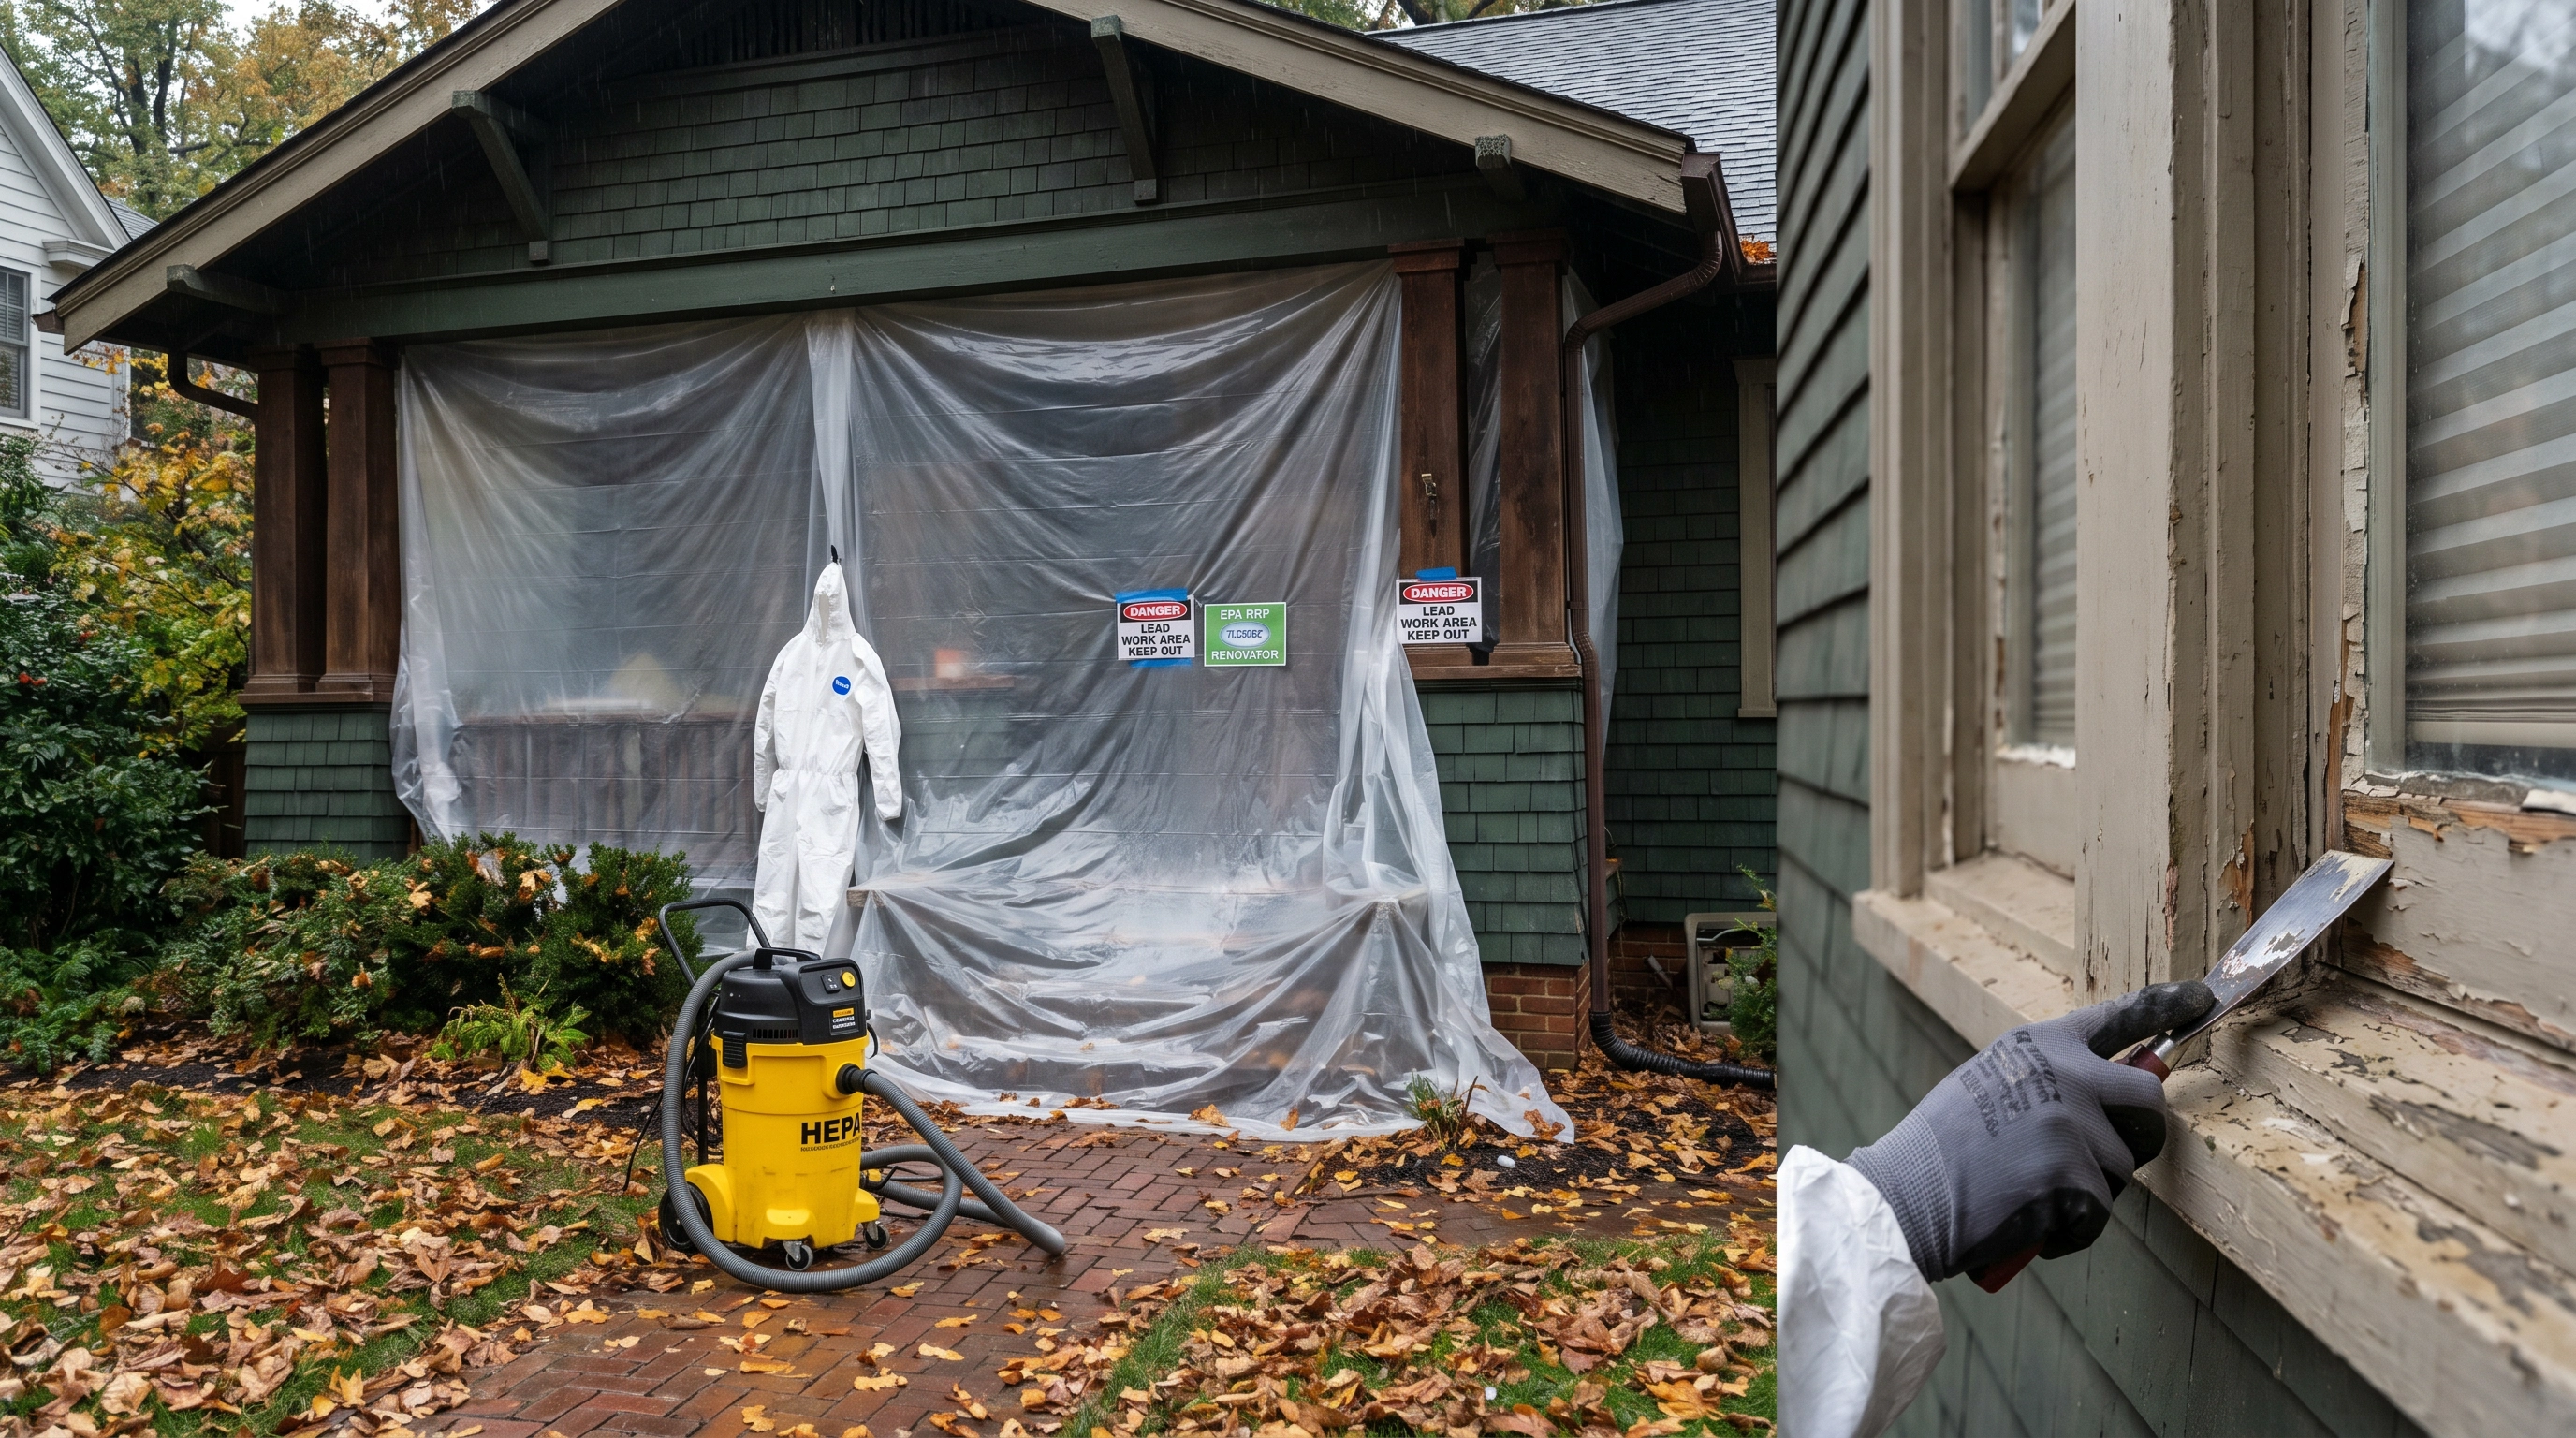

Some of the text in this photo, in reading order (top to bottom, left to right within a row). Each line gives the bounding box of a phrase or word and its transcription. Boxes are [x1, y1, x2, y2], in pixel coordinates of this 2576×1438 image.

[1411, 587, 1467, 598] DANGER
[1130, 604, 1181, 617] DANGER
[1220, 609, 1270, 620] EPA RRP
[1423, 606, 1455, 616] LEAD
[1400, 617, 1477, 628] WORK AREA
[1141, 624, 1170, 634] LEAD
[1407, 629, 1469, 640] KEEP OUT
[1121, 634, 1191, 646] WORK AREA
[1128, 645, 1183, 656] KEEP OUT
[801, 1112, 860, 1145] HEPA
